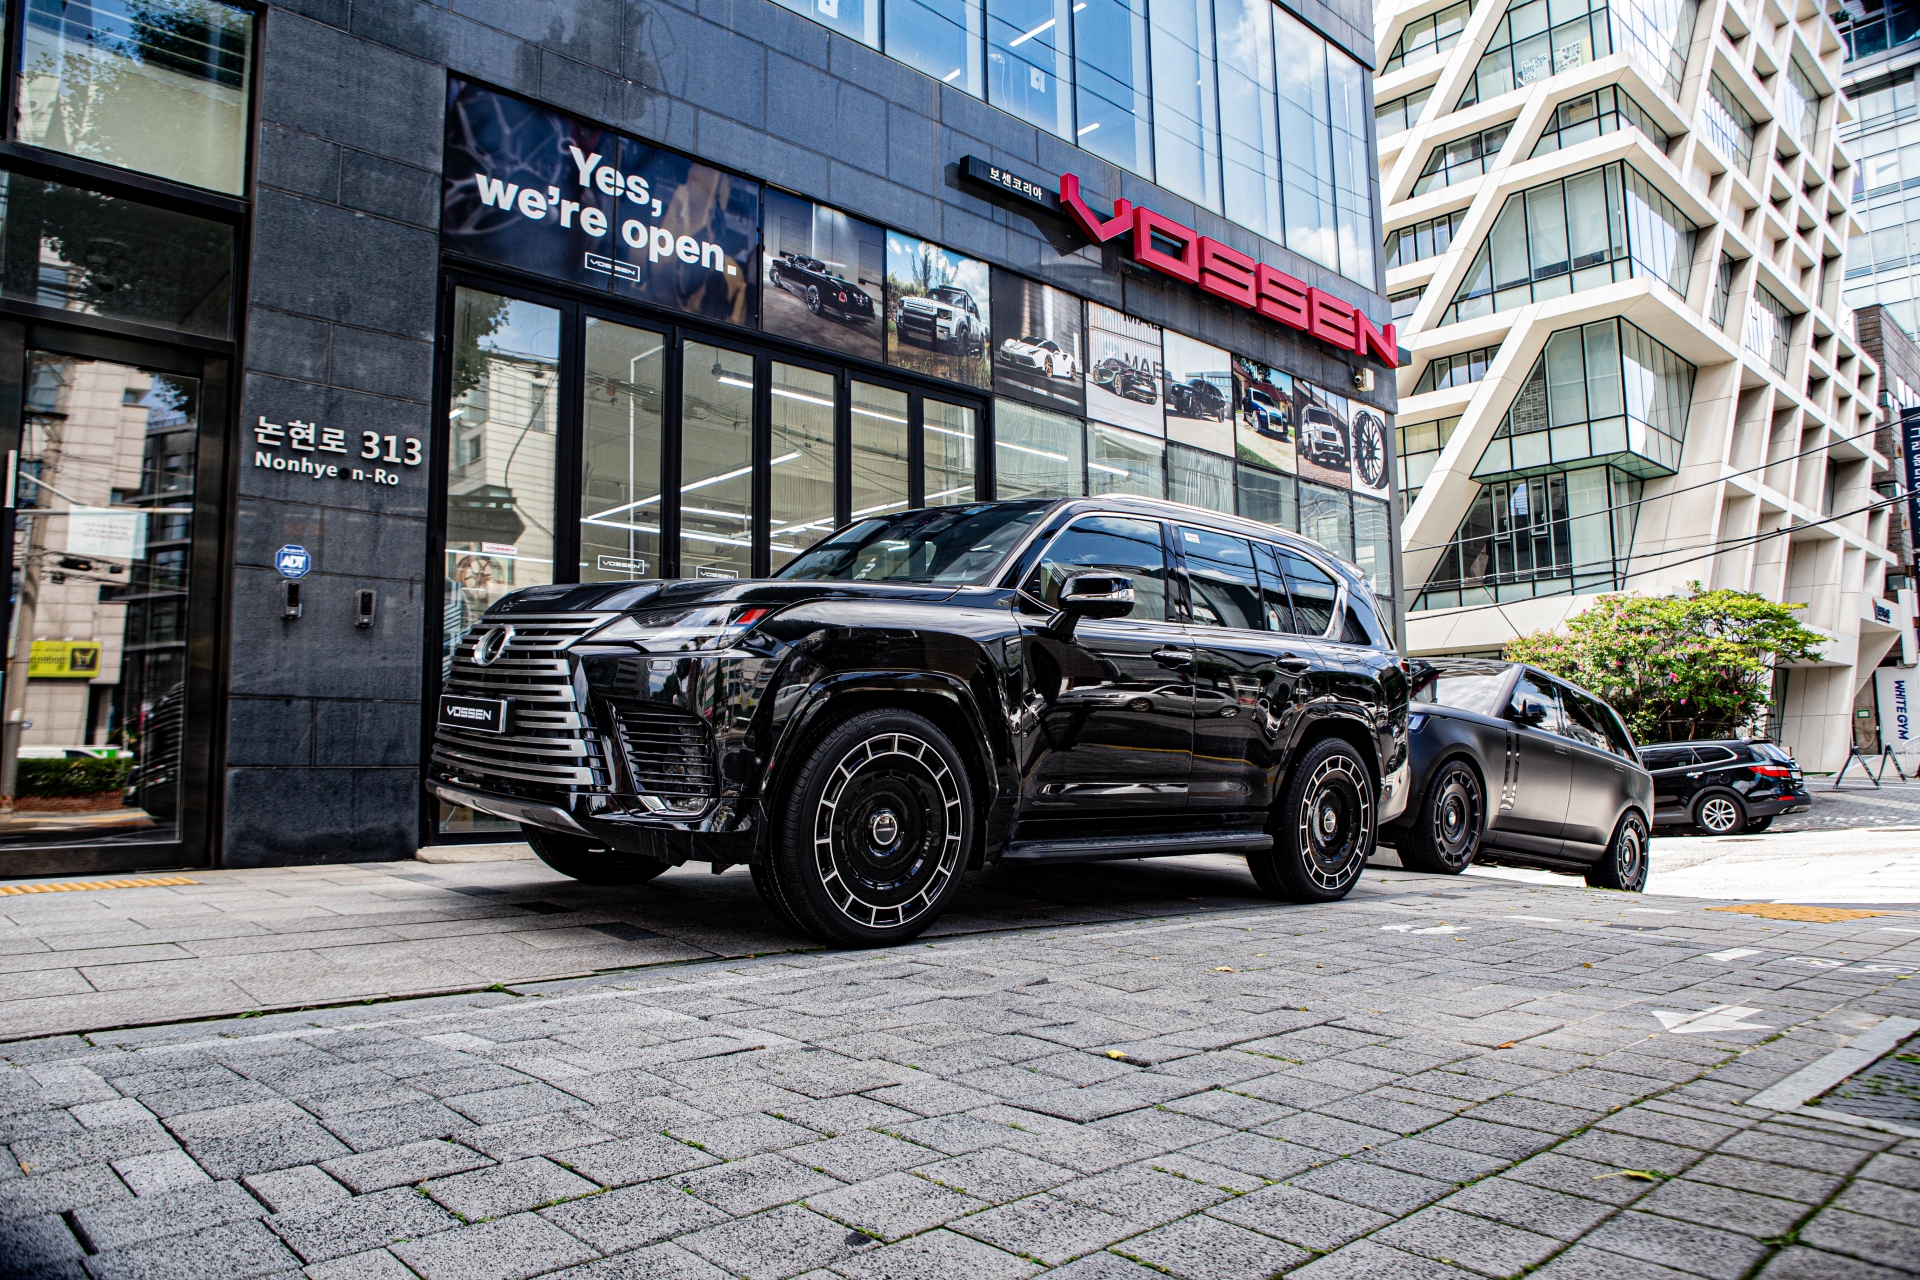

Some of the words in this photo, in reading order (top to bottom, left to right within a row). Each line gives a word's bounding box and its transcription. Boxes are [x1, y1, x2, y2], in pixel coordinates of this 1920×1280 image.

[569, 145, 662, 217] Yes,
[989, 167, 1042, 200] 보센코리아
[475, 173, 608, 237] we're
[621, 219, 737, 276] open.
[590, 259, 636, 275] VOSSEN
[1060, 172, 1398, 369] VOSSEN
[253, 415, 348, 454] 논현로
[360, 430, 423, 466] 313
[254, 451, 400, 486] Nonhyen-Ro
[280, 555, 306, 569] ADT
[602, 560, 640, 569] VOSSEN
[446, 705, 492, 721] VOSSEN
[1894, 680, 1907, 713] WHITE
[1897, 715, 1910, 741] GYM
